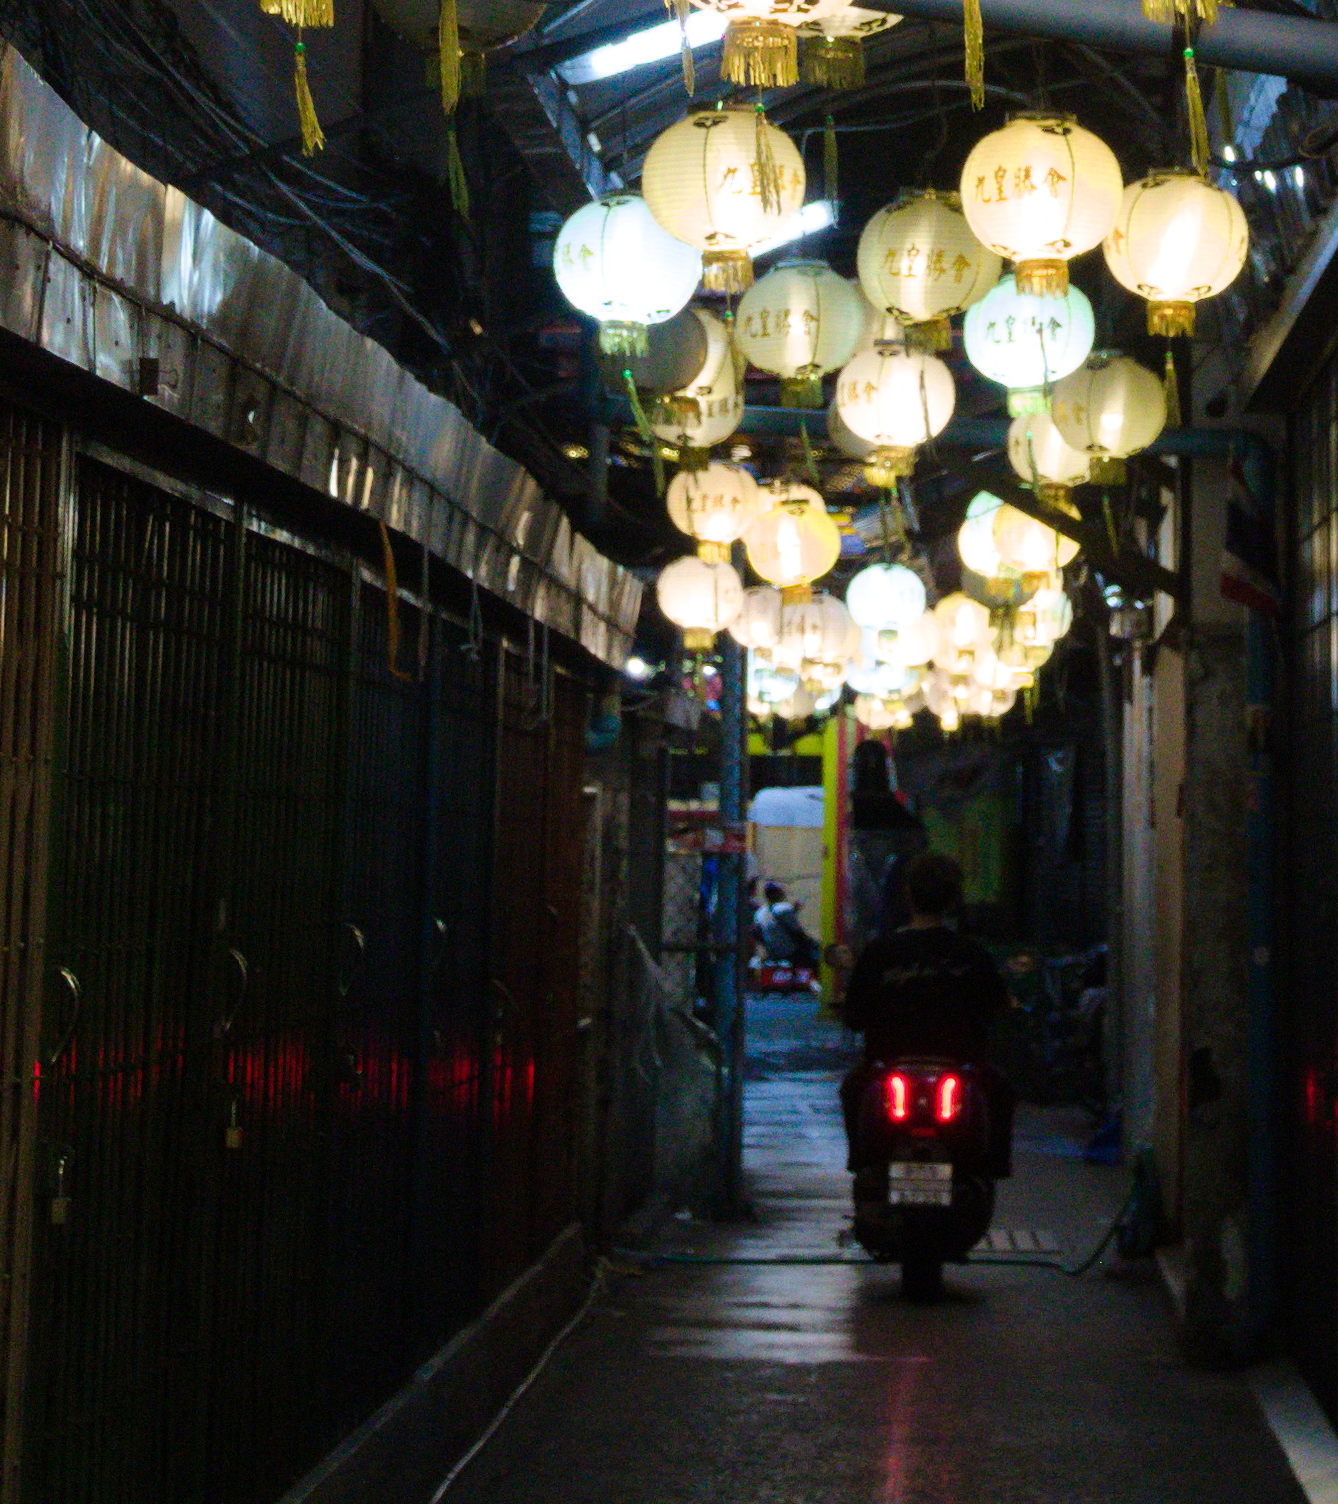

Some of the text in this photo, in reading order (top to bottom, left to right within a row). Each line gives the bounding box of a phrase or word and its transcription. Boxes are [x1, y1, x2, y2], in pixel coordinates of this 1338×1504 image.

[974, 164, 1067, 203] 九皇勝會
[883, 245, 972, 283] 九皇勝會
